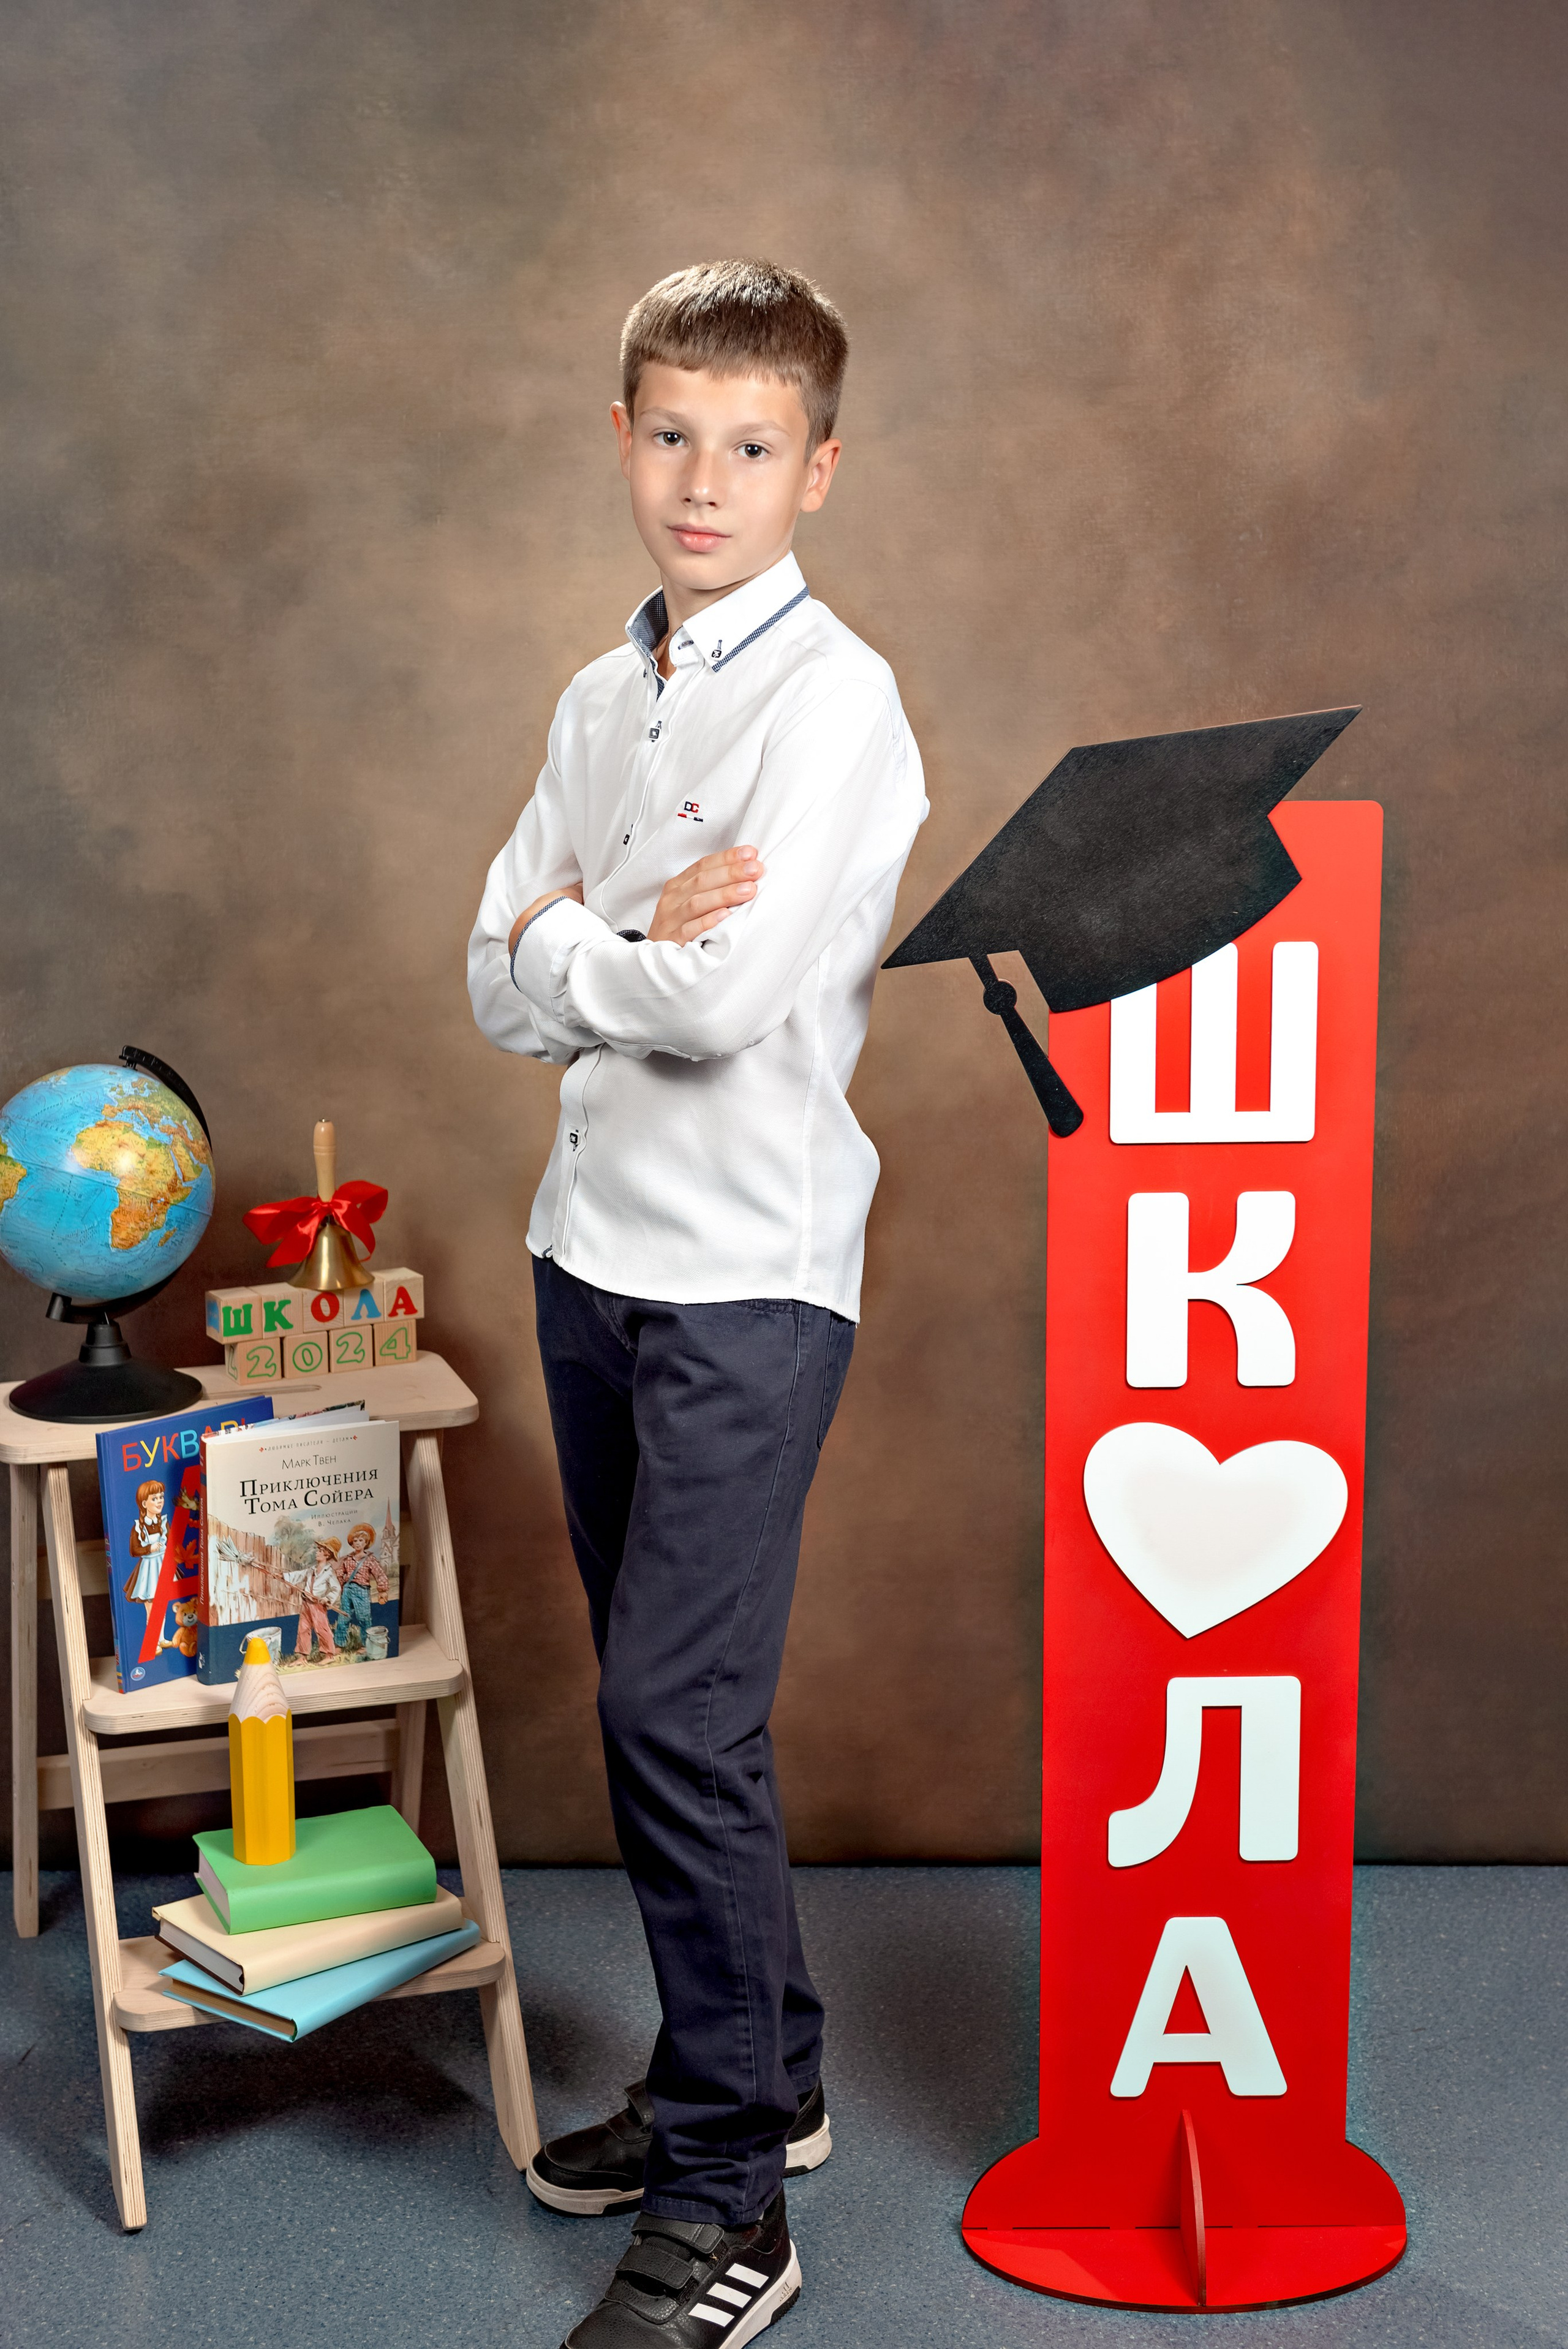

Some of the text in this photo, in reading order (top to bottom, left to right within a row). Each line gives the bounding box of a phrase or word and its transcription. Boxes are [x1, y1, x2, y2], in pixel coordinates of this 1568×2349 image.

[684, 801, 699, 812] DC
[222, 1286, 418, 1337] ШКОЛА
[246, 1327, 411, 1378] 2024
[282, 1454, 336, 1470] МАРК ТВЕН
[239, 1469, 378, 1497] ПРИКЛЮЧЕНИЯ
[244, 1488, 374, 1515] ТОМА СОЙЕРА
